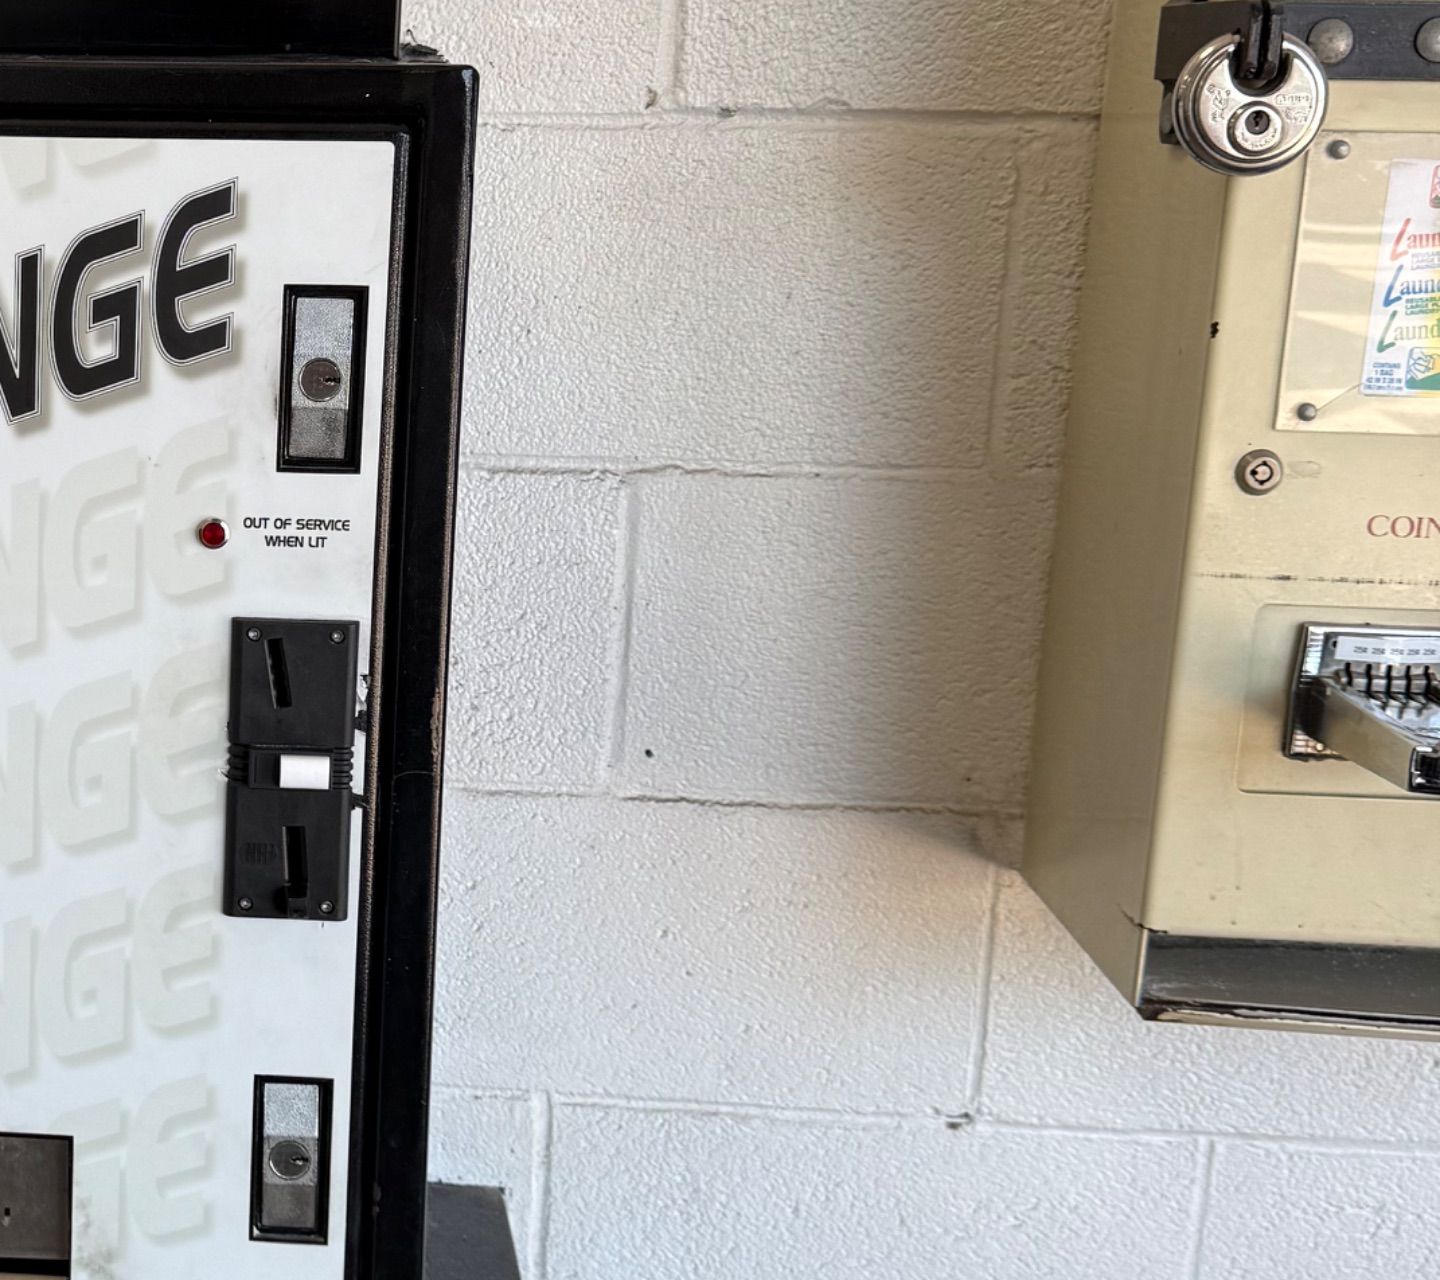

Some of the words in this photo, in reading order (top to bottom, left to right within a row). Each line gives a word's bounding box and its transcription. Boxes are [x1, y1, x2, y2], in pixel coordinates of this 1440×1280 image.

[242, 516, 270, 530] OUT
[273, 517, 292, 530] OF
[295, 518, 351, 532] SERVICE
[264, 534, 305, 548] WHEN
[308, 536, 328, 548] LIT
